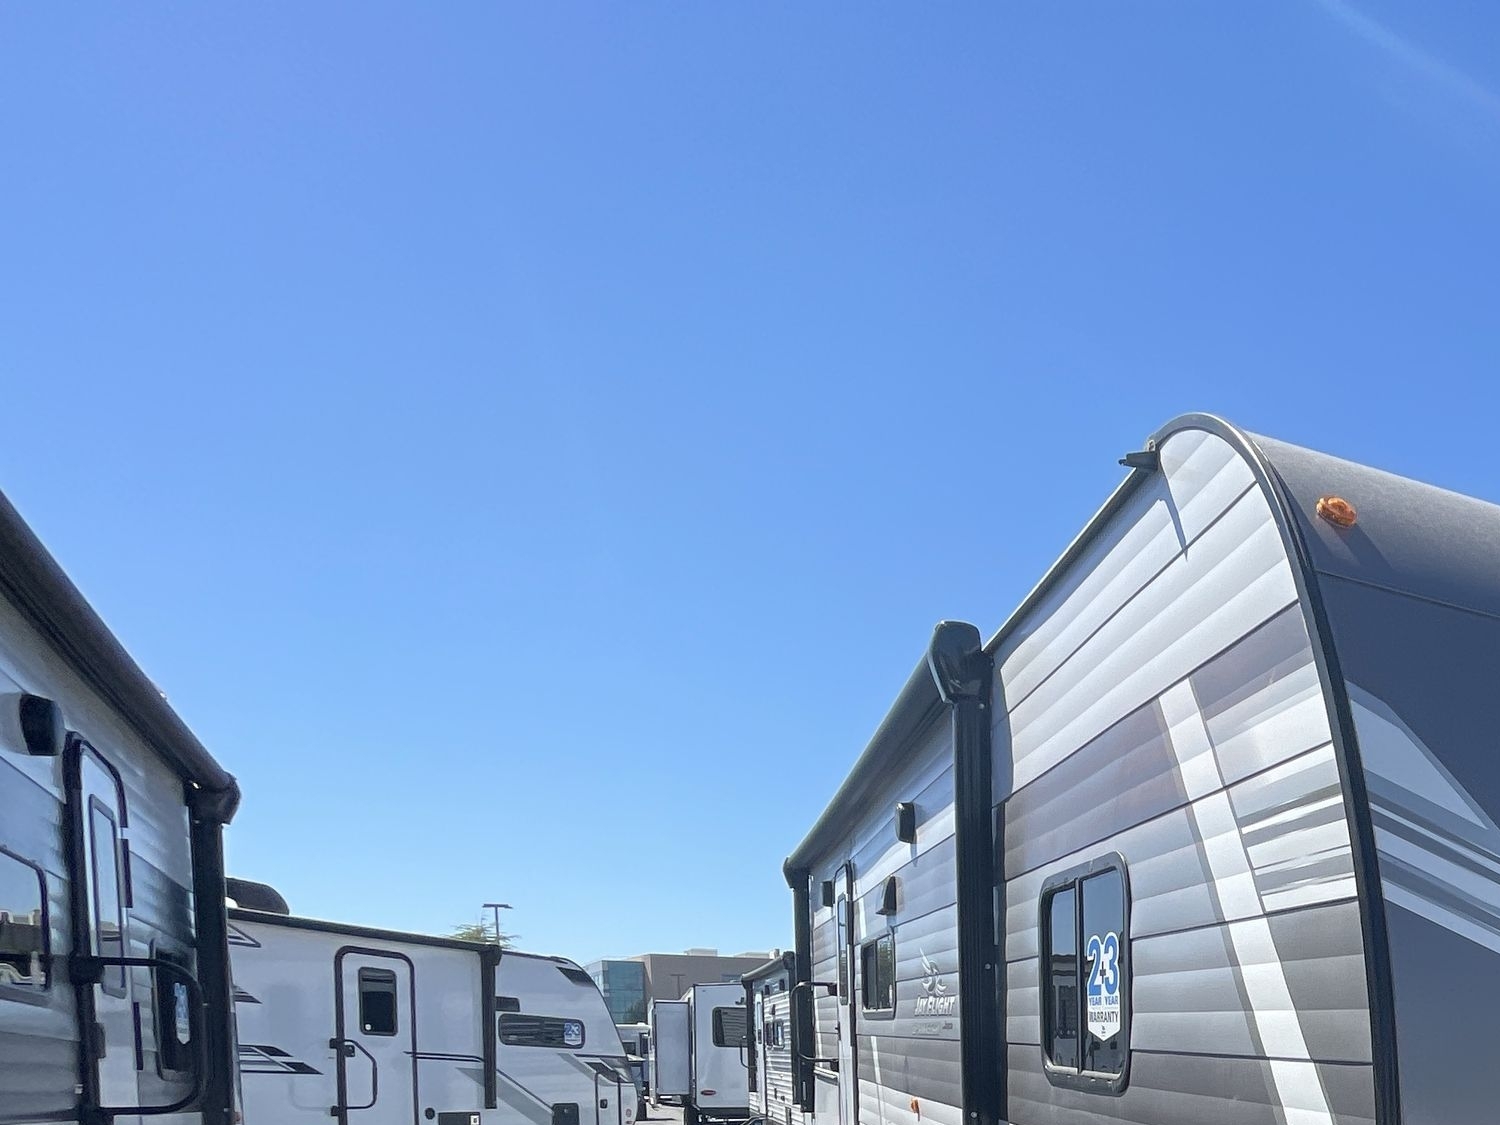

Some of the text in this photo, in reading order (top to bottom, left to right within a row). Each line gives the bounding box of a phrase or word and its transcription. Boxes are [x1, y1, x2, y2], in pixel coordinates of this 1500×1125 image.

[1088, 995, 1119, 1007] YEAR YEAR
[1088, 1010, 1119, 1023] WARRANTY
